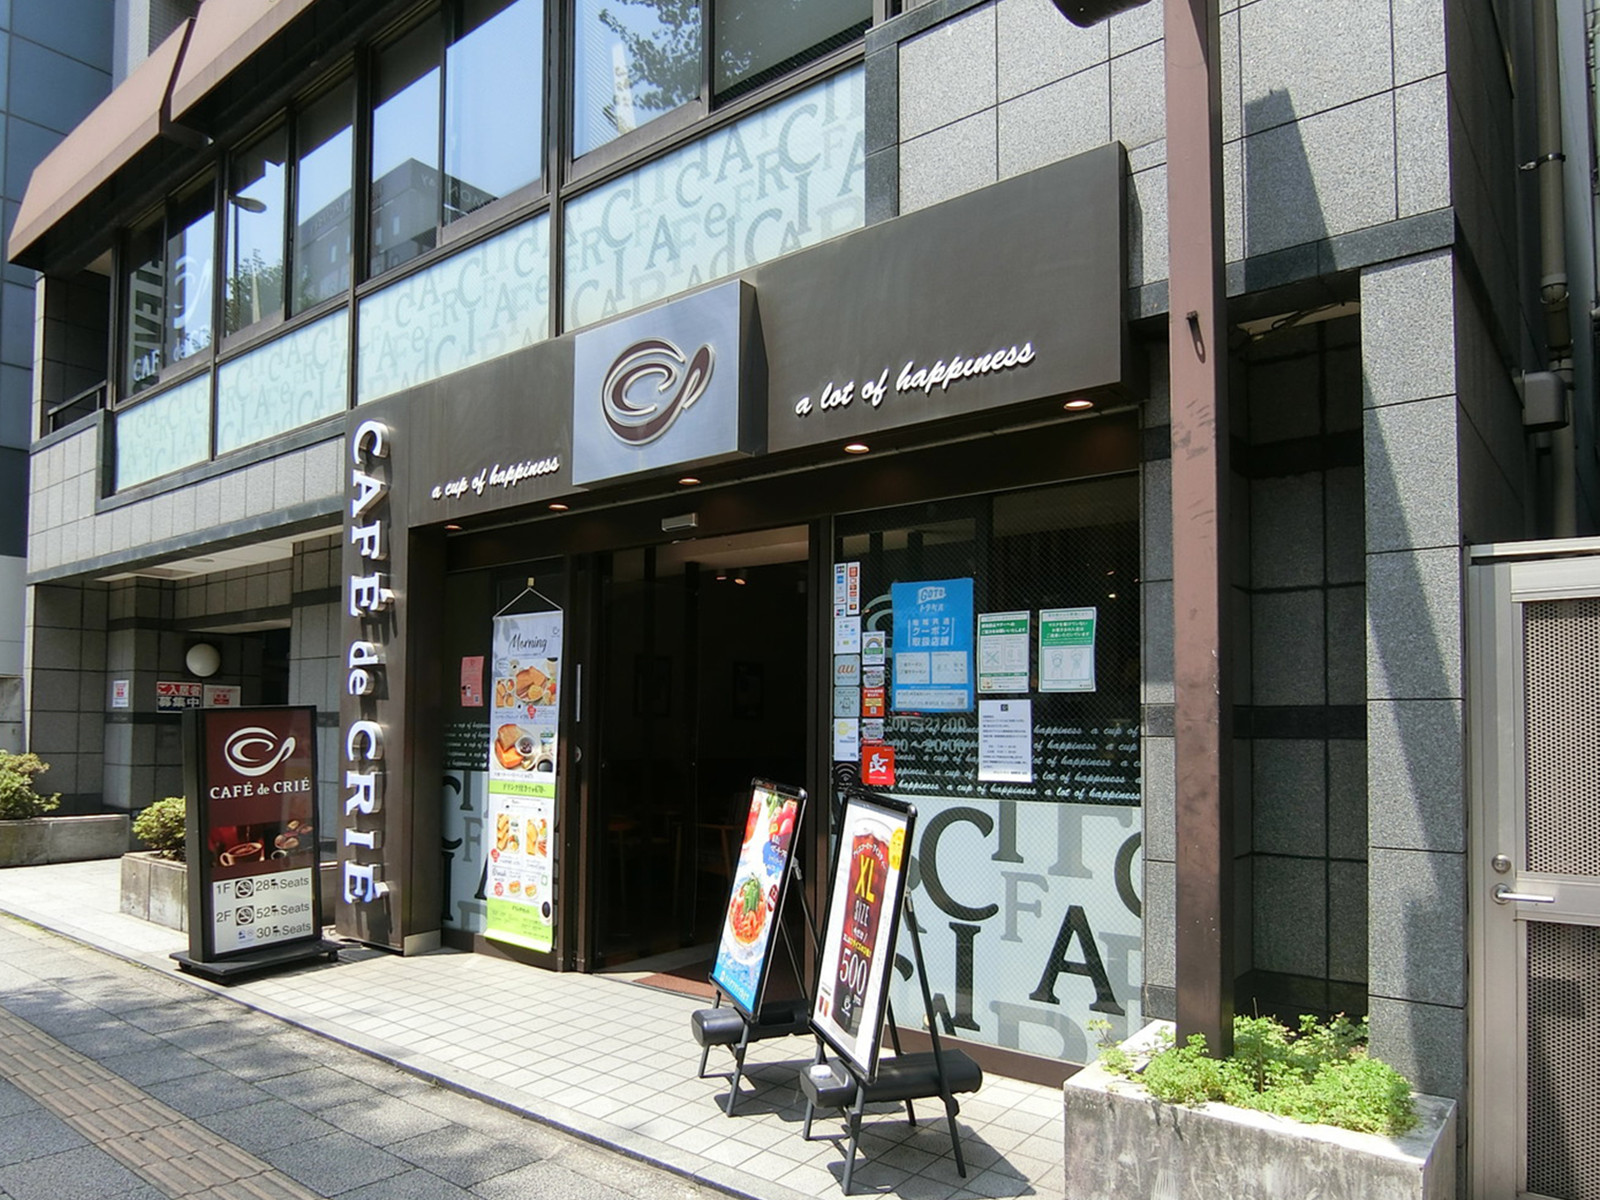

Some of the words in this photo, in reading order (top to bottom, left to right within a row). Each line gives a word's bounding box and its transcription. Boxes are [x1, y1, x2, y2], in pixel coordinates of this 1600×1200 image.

[795, 397, 812, 415] a
[820, 381, 855, 410] lot
[861, 368, 890, 407] of
[895, 342, 1036, 393] happiness
[432, 486, 442, 499] a
[445, 477, 468, 499] cup
[471, 468, 487, 495] of
[489, 457, 560, 488] happiness
[350, 420, 395, 617] CAFÉ
[912, 626, 950, 636] クーポン
[508, 633, 547, 654] Morning
[348, 641, 384, 695] de
[837, 664, 856, 674] au
[1033, 724, 1082, 736] happiness
[1103, 727, 1122, 737] cup
[1127, 725, 1139, 738] of
[1033, 740, 1043, 752] of
[1047, 740, 1096, 752] happiness
[1118, 743, 1137, 753] cup
[1046, 755, 1058, 767] of
[1061, 755, 1111, 767] happiness
[945, 769, 960, 778] cup
[964, 768, 975, 779] of
[1042, 770, 1056, 781] lot
[1060, 772, 1071, 783] of
[1074, 771, 1126, 784] happiness
[210, 781, 254, 799] CAFÉ
[257, 783, 270, 795] de
[273, 776, 311, 793] CRIÉ
[898, 779, 939, 790] happiness
[957, 784, 973, 793] cup
[977, 783, 988, 794] of
[990, 783, 1037, 796] happiness
[1056, 787, 1071, 797] lot
[1074, 787, 1085, 799] of
[1089, 787, 1140, 800] happiness
[343, 719, 390, 904] CRIÉ
[217, 882, 231, 894] 1F
[256, 880, 270, 892] 28
[280, 877, 309, 889] Seats
[855, 854, 875, 903] XL
[216, 910, 231, 923] 2F
[256, 907, 271, 919] 52
[280, 903, 310, 915] Seats
[854, 899, 870, 927] SIZE
[256, 926, 271, 939] 30
[282, 923, 311, 935] Seats
[1029, 905, 1125, 1016] A
[840, 947, 867, 996] 500
